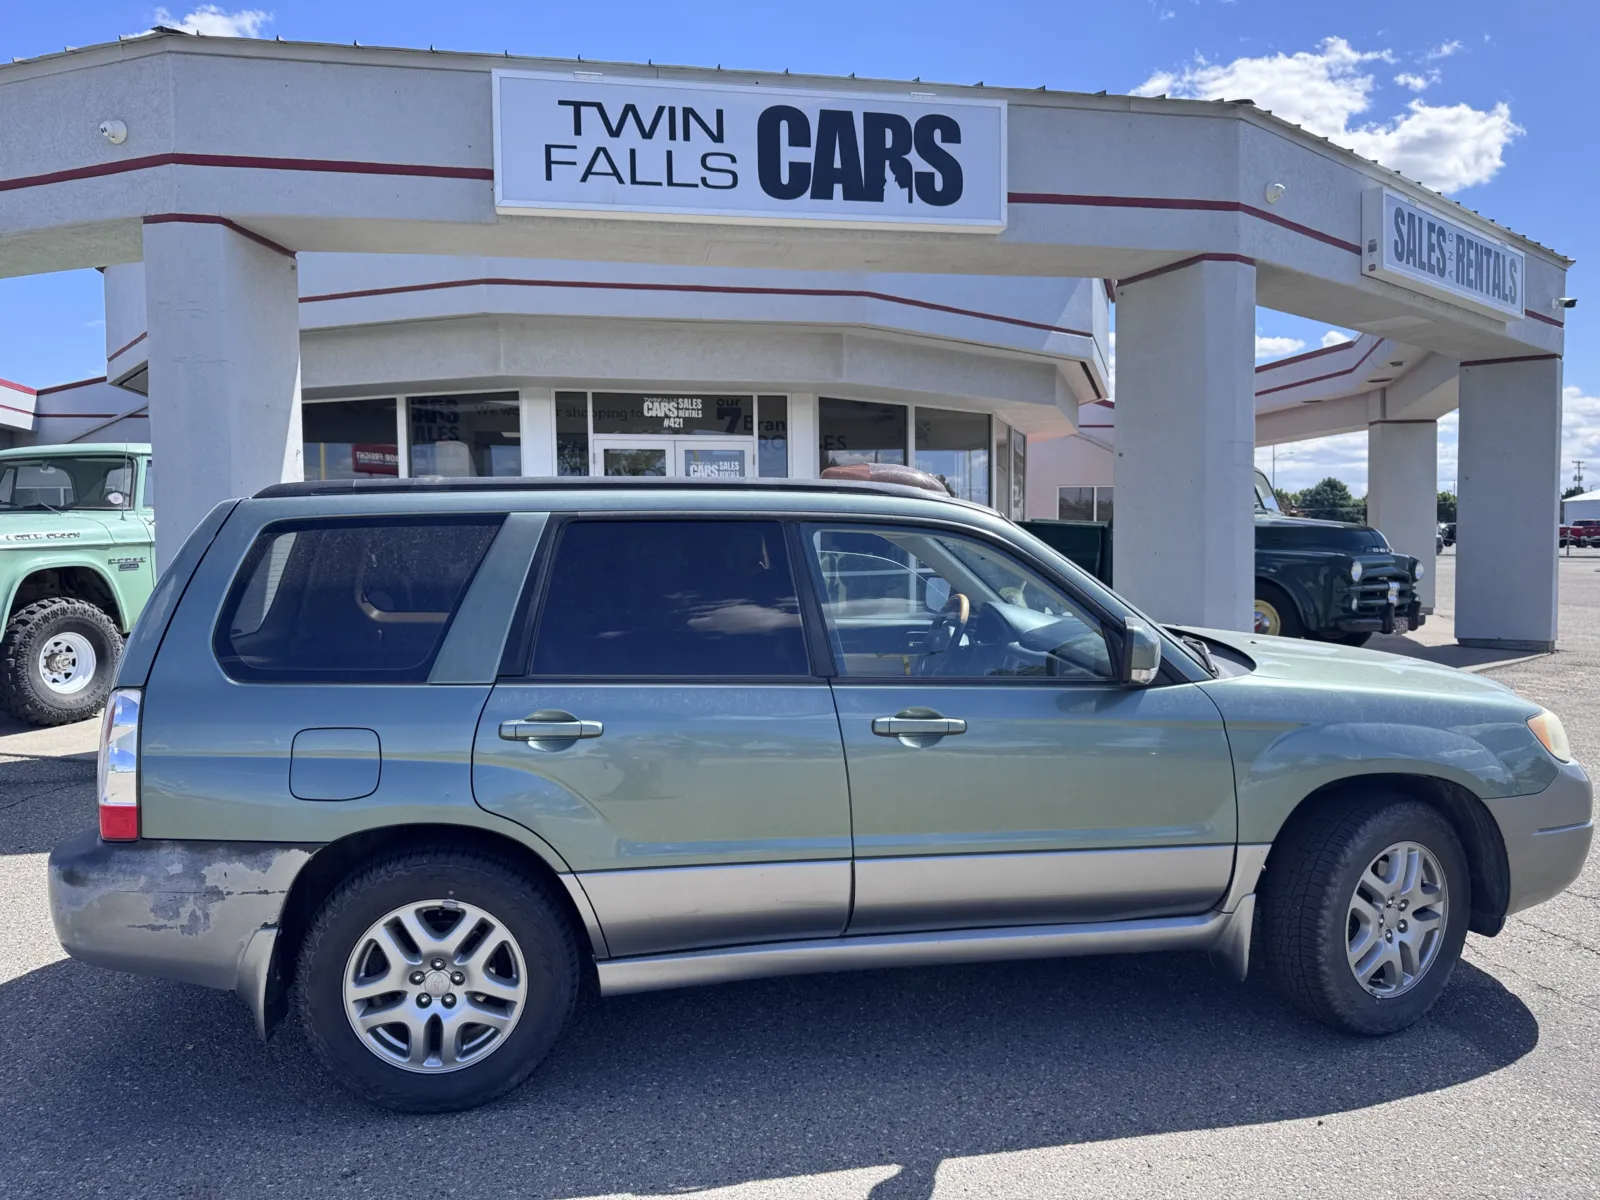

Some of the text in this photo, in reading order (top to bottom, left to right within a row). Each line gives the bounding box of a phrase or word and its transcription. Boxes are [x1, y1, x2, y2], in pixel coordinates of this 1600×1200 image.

[557, 99, 725, 144] TWIN
[756, 104, 964, 208] CARS
[543, 143, 739, 190] FALLS
[1393, 206, 1447, 279] SALES
[1455, 233, 1518, 305] RENTALS
[643, 401, 678, 417] CARS
[678, 398, 703, 409] SALES
[716, 397, 741, 407] our
[678, 409, 703, 418] RENTALS
[716, 406, 742, 434] 7
[663, 417, 684, 428] #421
[690, 464, 719, 477] CARS
[719, 460, 740, 471] SALES
